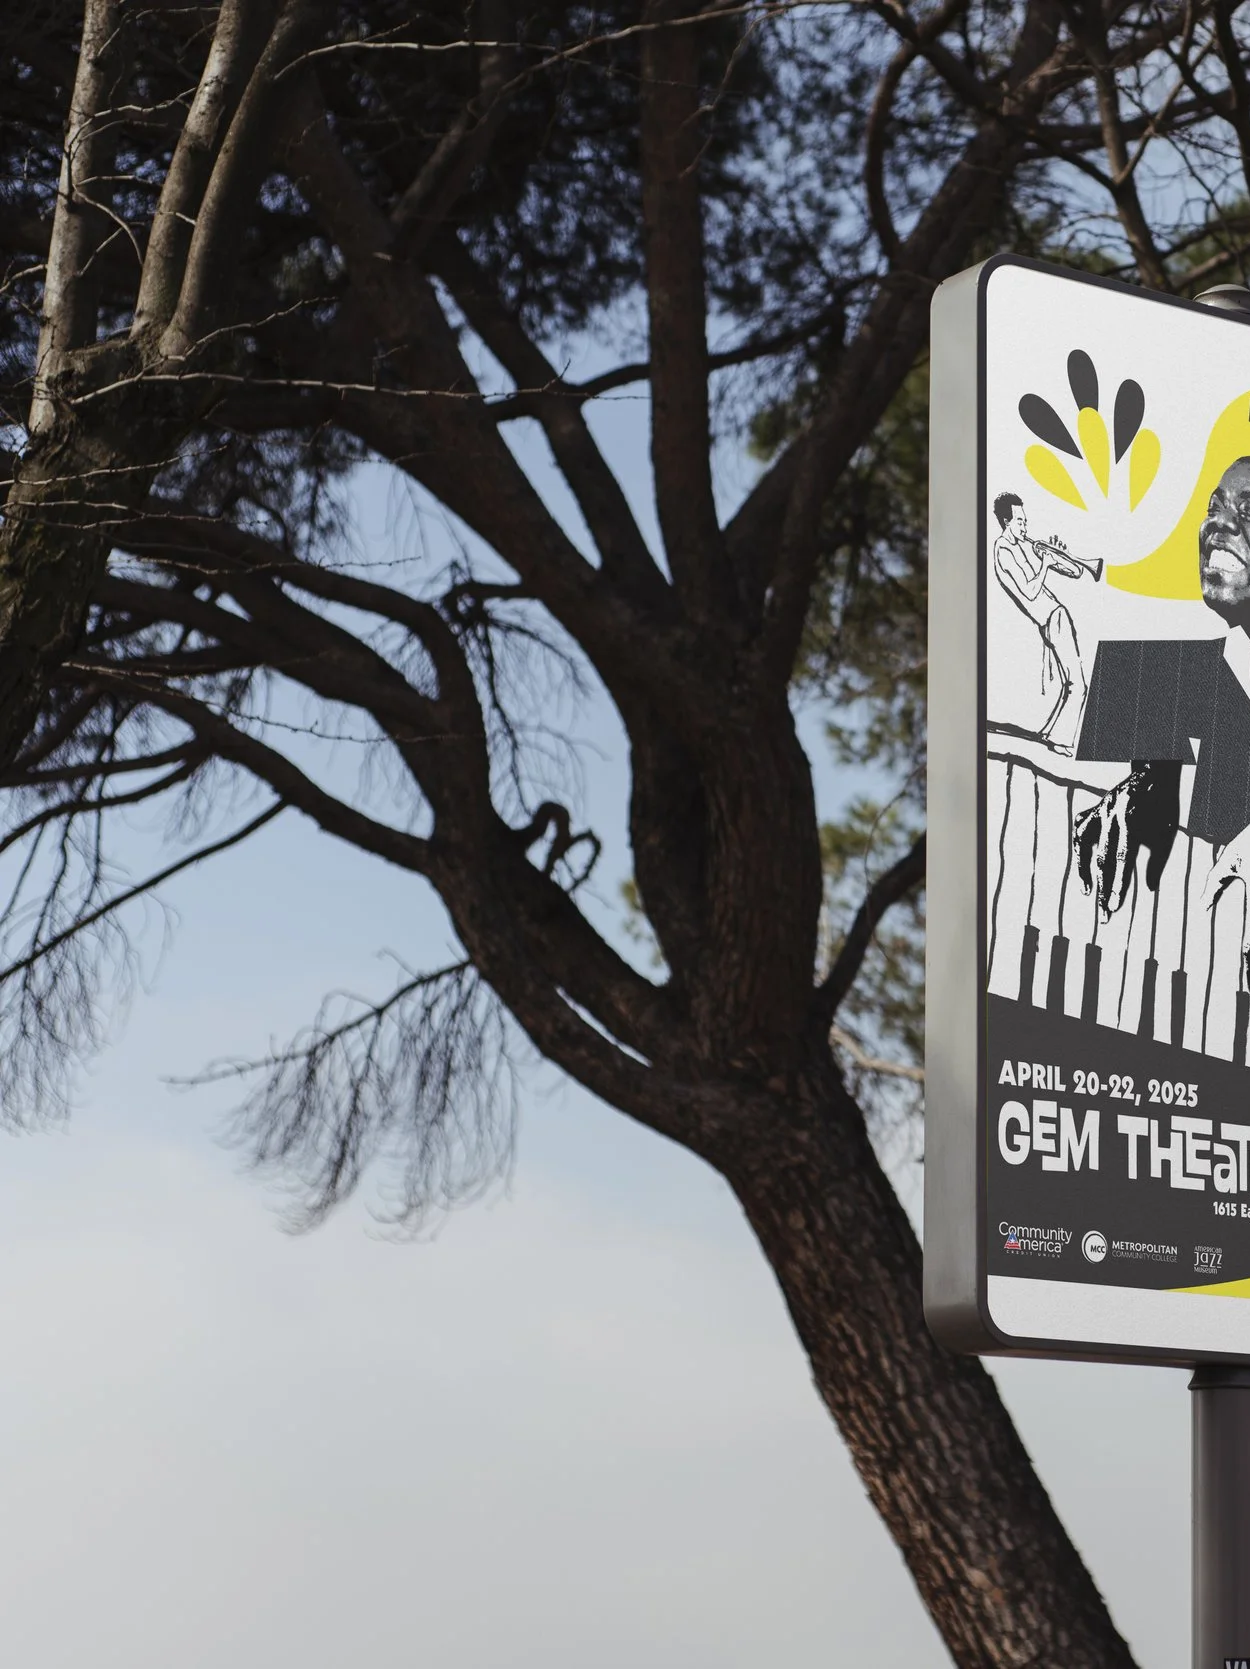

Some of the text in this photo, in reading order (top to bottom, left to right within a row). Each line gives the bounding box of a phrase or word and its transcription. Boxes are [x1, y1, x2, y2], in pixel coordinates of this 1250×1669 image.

[998, 1059, 1199, 1107] APRIL 20-22, 2025
[998, 1099, 1100, 1172] GEM
[1213, 1201, 1237, 1218] 1615
[998, 1221, 1073, 1245] Community
[1090, 1244, 1106, 1254] MCC
[1112, 1241, 1178, 1255] METROPOLITAN
[1112, 1250, 1178, 1263] COMMUNITY COLLEGE
